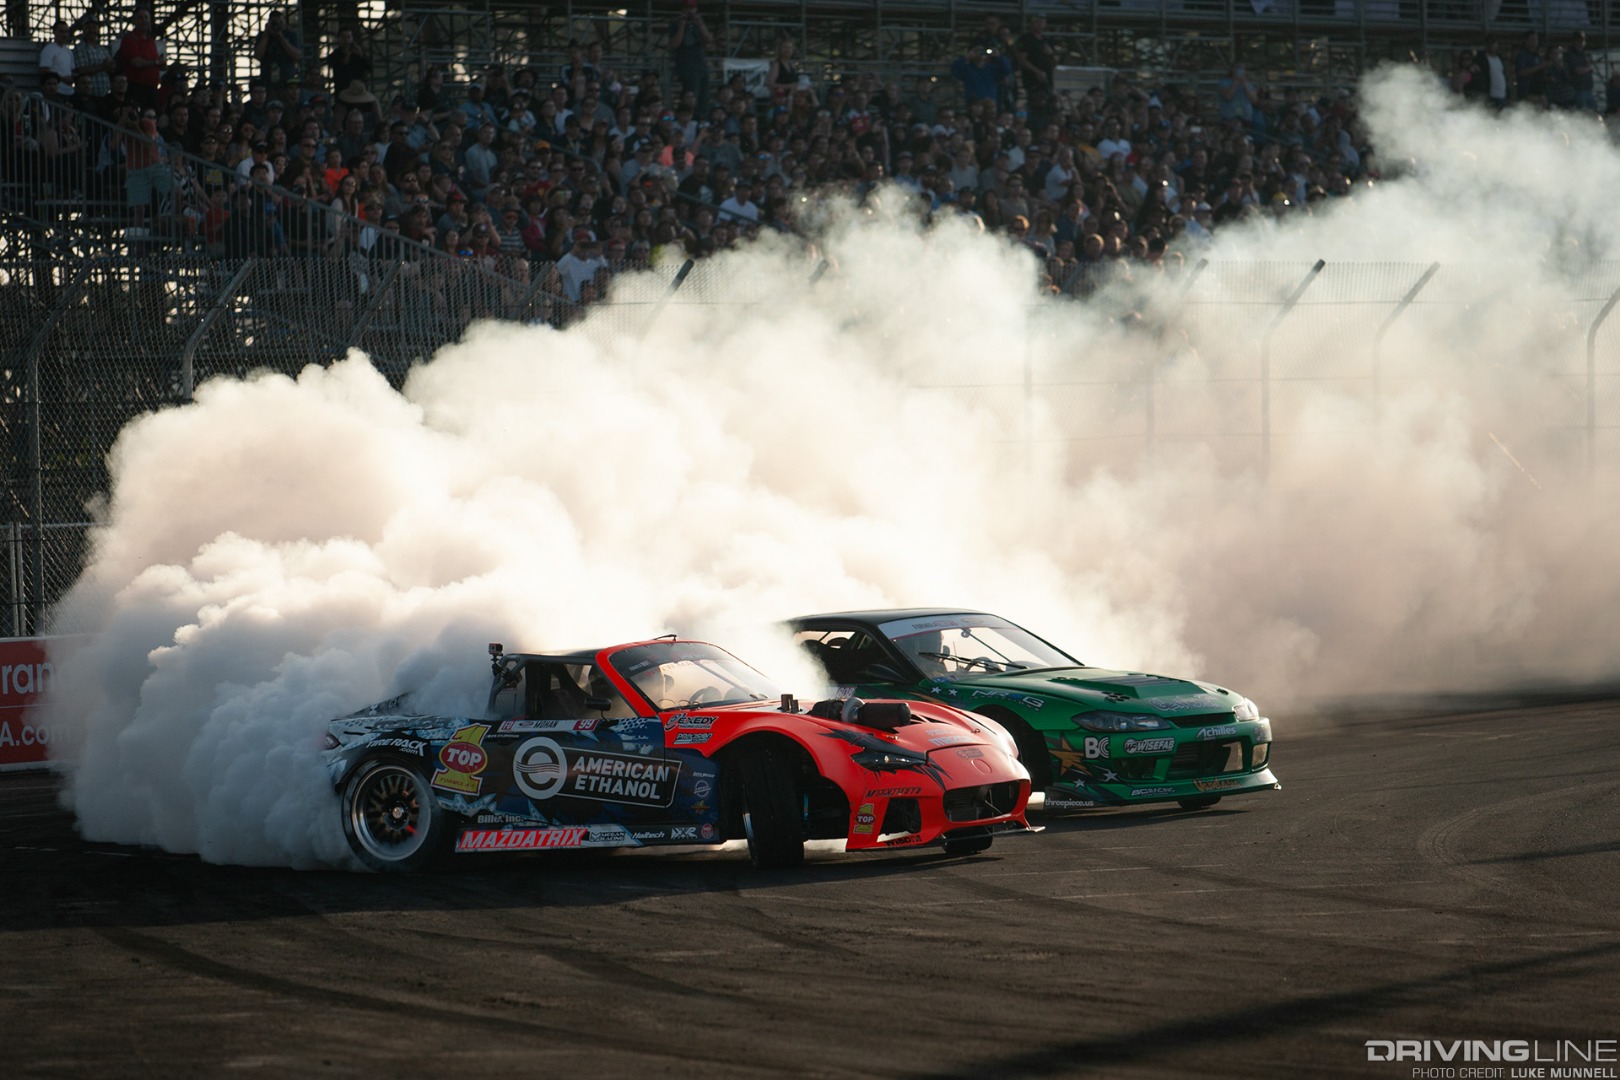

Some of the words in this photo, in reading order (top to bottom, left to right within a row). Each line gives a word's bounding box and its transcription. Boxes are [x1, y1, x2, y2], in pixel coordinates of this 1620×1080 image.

[579, 720, 593, 729] 99
[1197, 726, 1236, 739] Achilles
[366, 739, 391, 748] TIRE
[389, 738, 427, 757] RACK
[1084, 737, 1110, 759] BC
[1137, 739, 1175, 750] WISEFAB
[399, 747, 419, 755] .com
[446, 748, 482, 767] TOP
[572, 756, 670, 782] AMERICAN
[574, 774, 661, 800] ETHANOL
[1044, 798, 1094, 809] threepiece.us
[477, 814, 505, 824] Billet
[505, 814, 524, 822] Inc.
[857, 815, 875, 823] TOP
[461, 829, 587, 848] MAZDATRIX
[632, 831, 665, 840] Haltech
